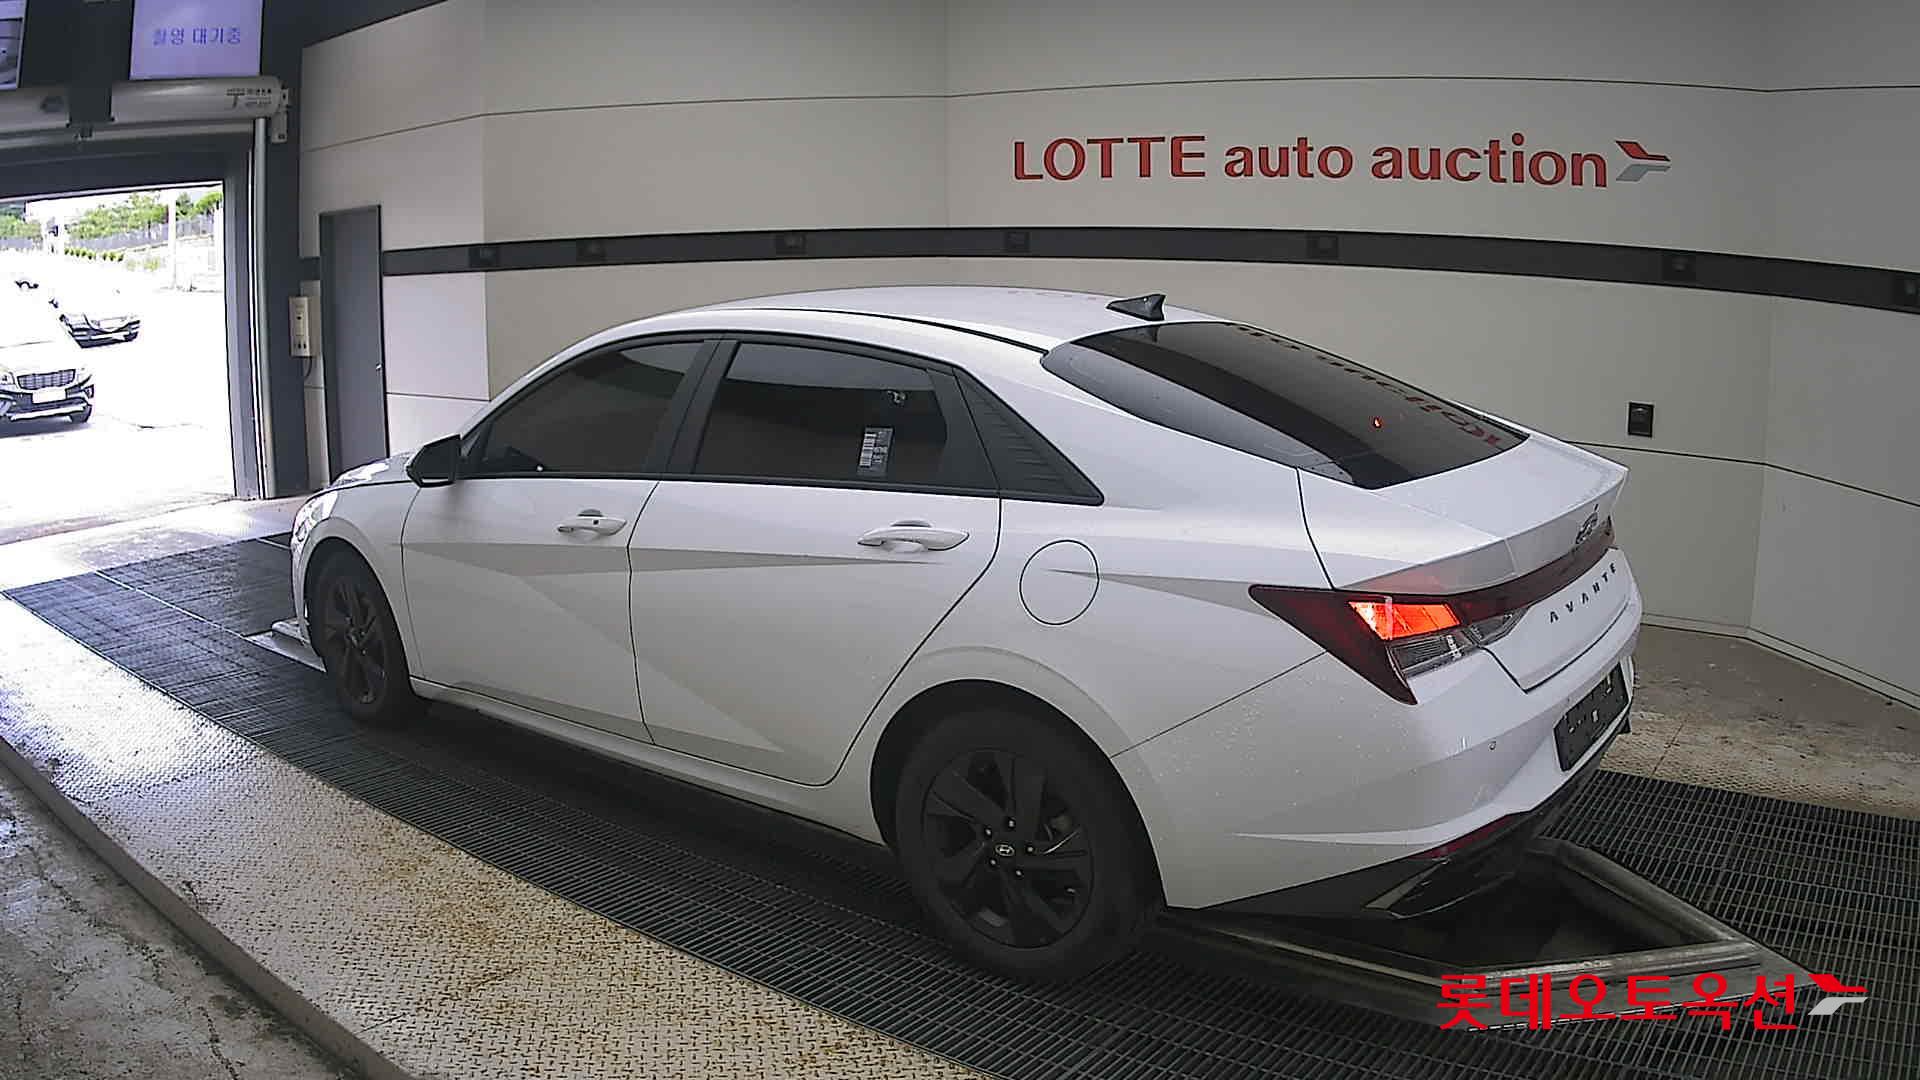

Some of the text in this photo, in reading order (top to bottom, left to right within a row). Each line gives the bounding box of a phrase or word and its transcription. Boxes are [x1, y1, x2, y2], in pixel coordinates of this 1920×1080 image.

[1014, 132, 1607, 187] LOTTE auto auction
[1549, 563, 1617, 623] AVANTE
